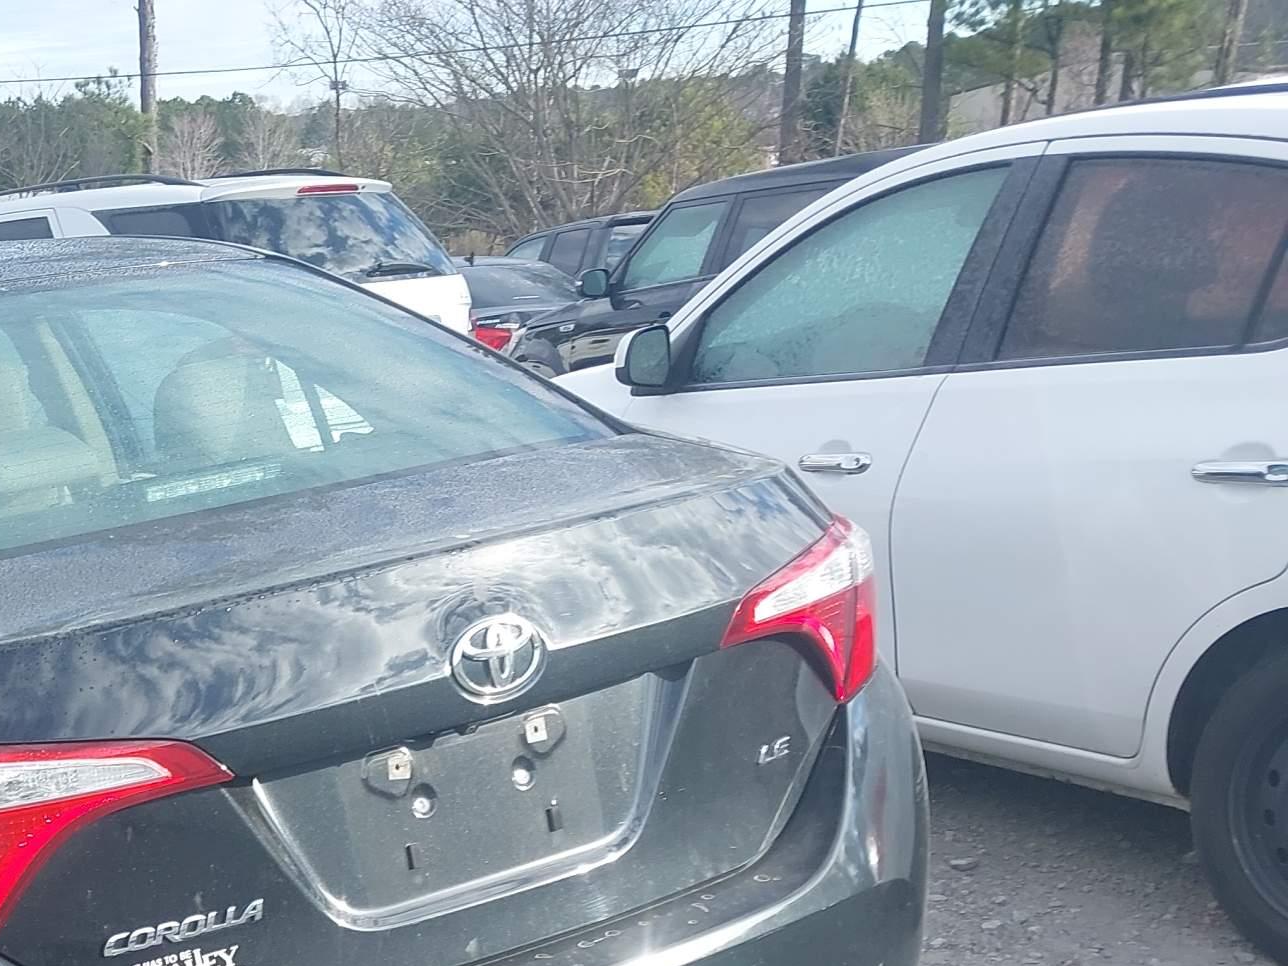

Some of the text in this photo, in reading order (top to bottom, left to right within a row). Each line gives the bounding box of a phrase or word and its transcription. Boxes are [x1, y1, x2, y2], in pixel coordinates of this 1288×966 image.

[758, 736, 790, 764] LE
[104, 898, 264, 957] COROLLA
[163, 954, 179, 965] TO
[179, 949, 192, 961] BE
